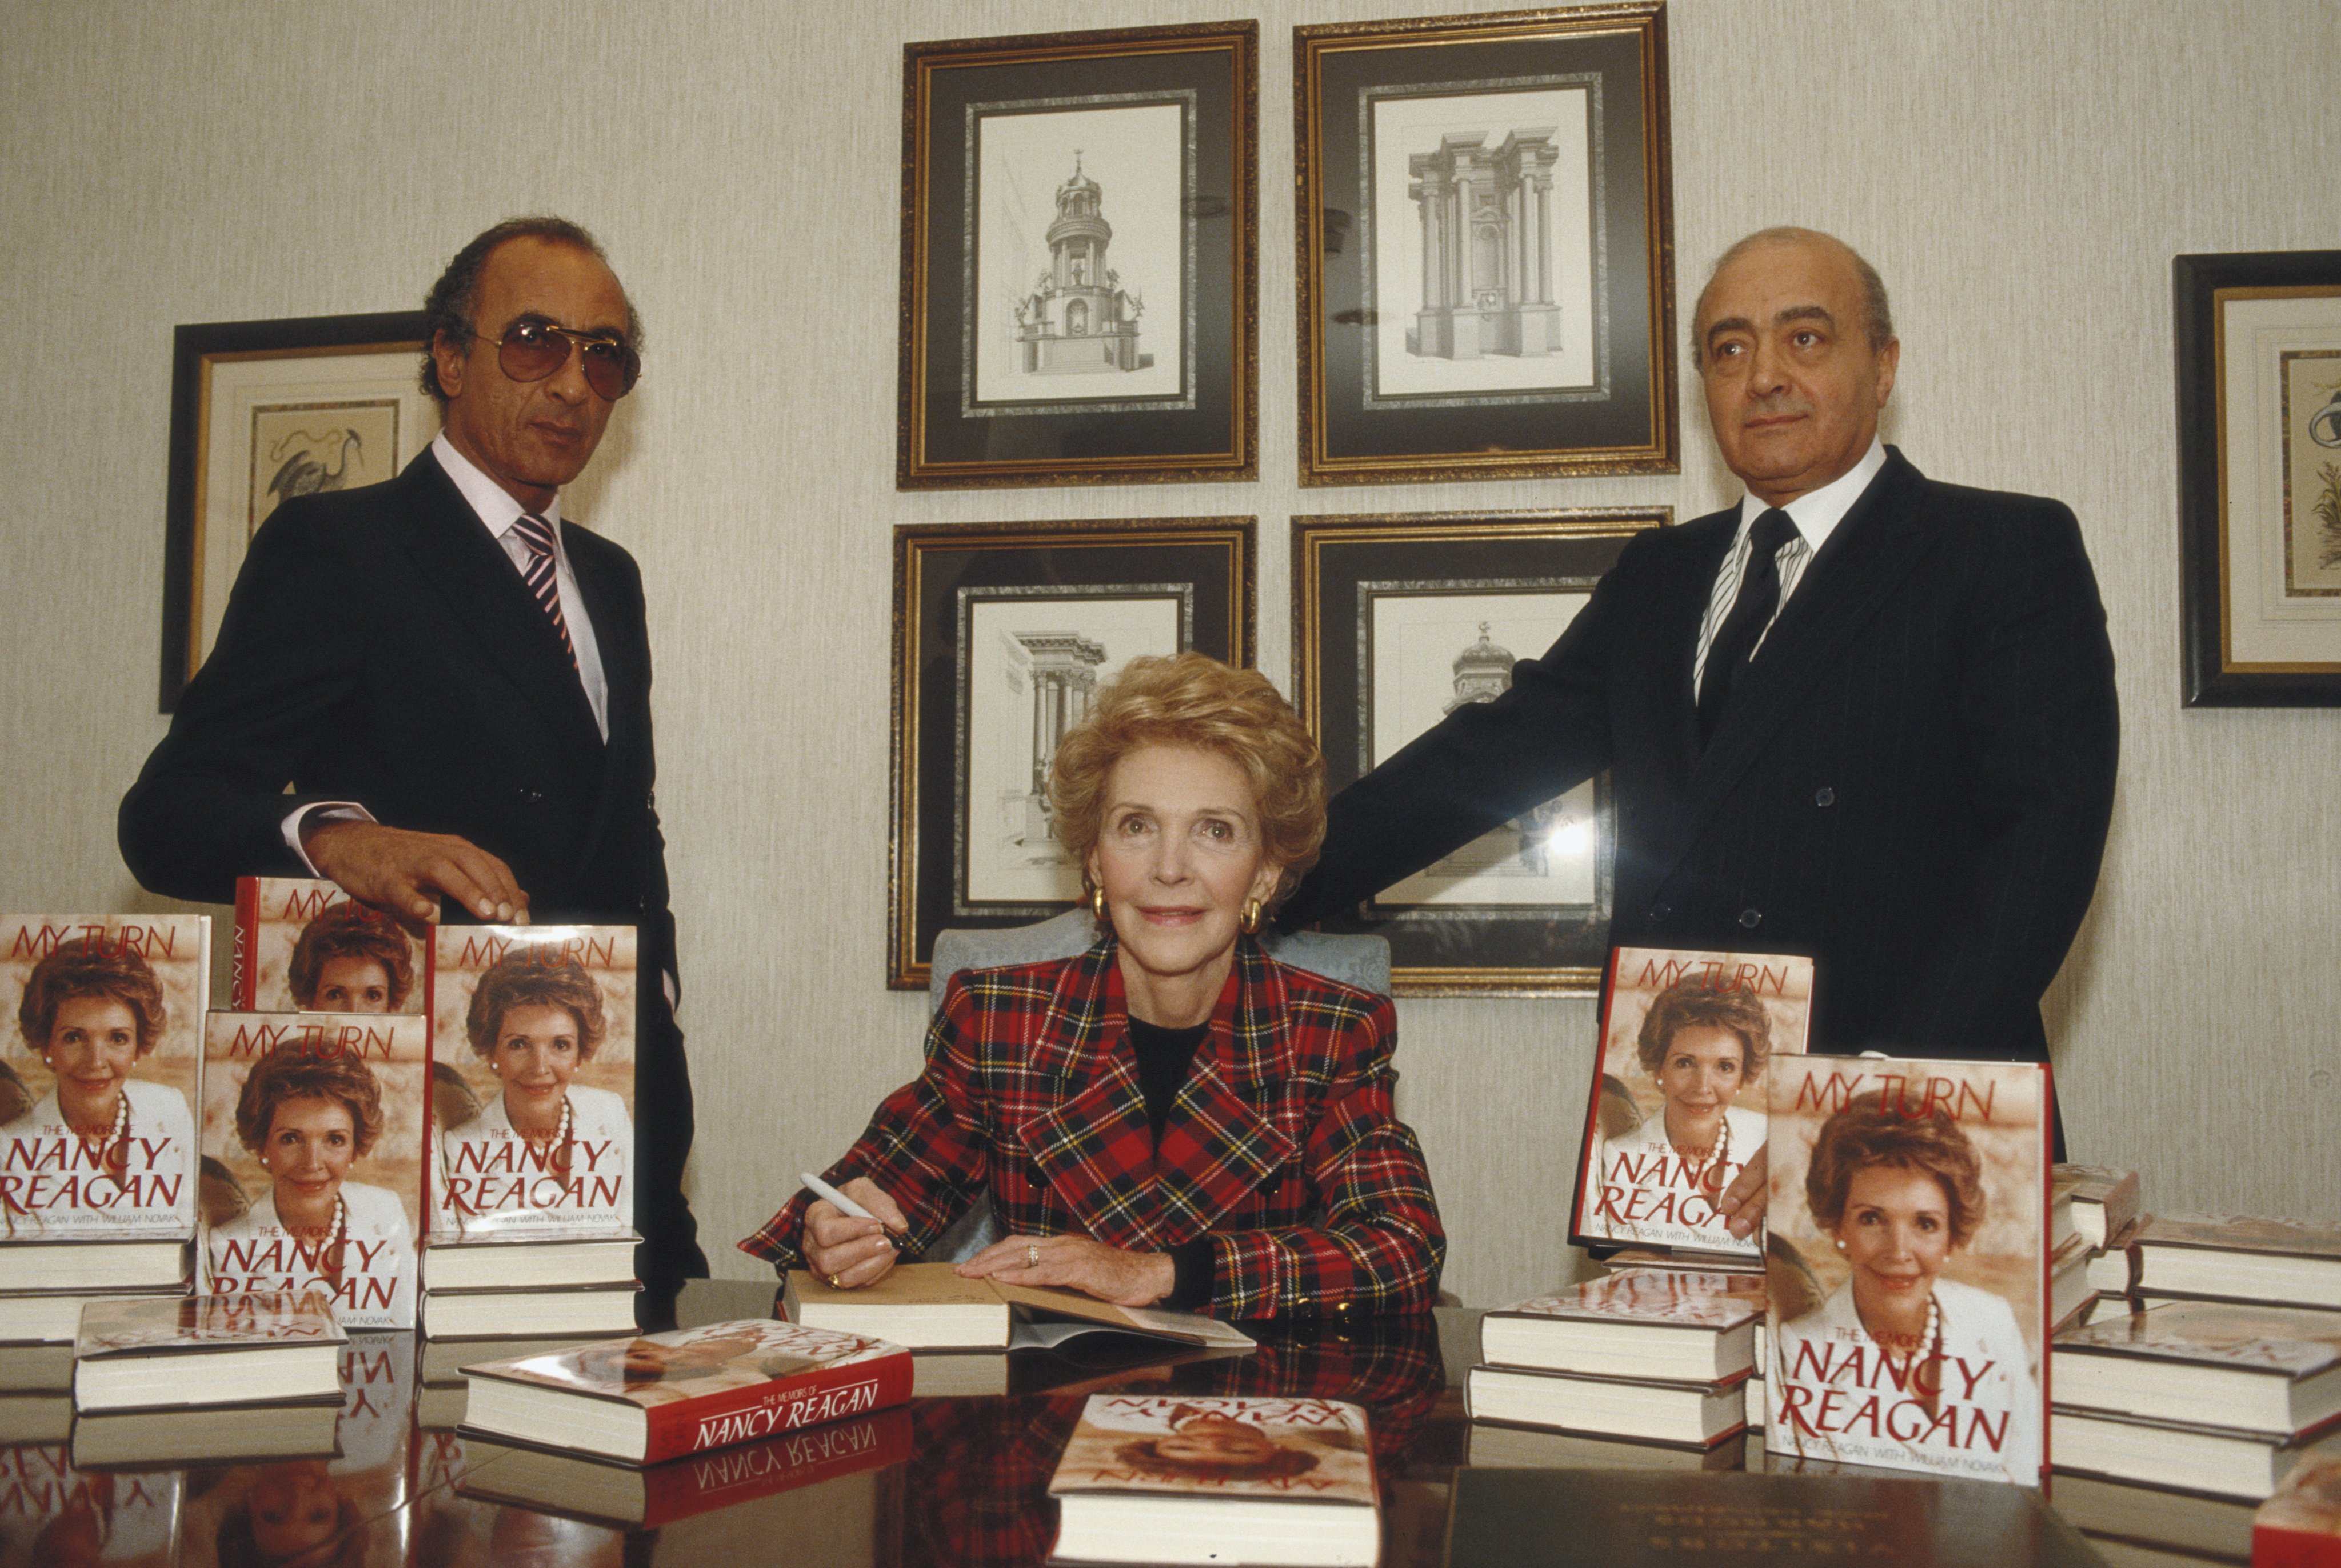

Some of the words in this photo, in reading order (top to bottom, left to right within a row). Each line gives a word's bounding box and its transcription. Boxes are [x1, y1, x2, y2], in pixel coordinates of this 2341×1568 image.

[283, 889, 336, 921] MY
[11, 925, 70, 958] MY
[78, 925, 176, 959] TURN
[458, 935, 513, 968] MY
[231, 925, 245, 1010] NANCY
[1637, 958, 1693, 990] MY
[1699, 961, 1788, 995] TURN
[229, 1023, 289, 1058] MY
[297, 1024, 394, 1060] TURN
[1796, 1071, 1865, 1114] MY
[1873, 1074, 1996, 1121] TURN
[43, 1124, 63, 1135] THE
[489, 1129, 510, 1139] THE
[5, 1137, 172, 1171] NANCY
[454, 1140, 612, 1173] NANCY
[1648, 1142, 1667, 1154] THE
[0, 1174, 183, 1215] REAGAN
[442, 1175, 622, 1216] REAGAN
[1593, 1186, 1733, 1229] REAGA
[73, 1214, 98, 1223] WITH
[102, 1213, 141, 1223] WILLIAM
[145, 1213, 175, 1223] NOVAK
[258, 1226, 279, 1237] THE
[519, 1215, 544, 1224] WITH
[547, 1214, 584, 1223] WILLIAM
[586, 1213, 616, 1222] NOVAK
[1629, 1226, 1663, 1238] REAGAN
[1666, 1230, 1689, 1241] WITH
[1693, 1234, 1729, 1245] WILLIAM
[1732, 1238, 1760, 1249] NOVA
[220, 1239, 387, 1273] NANCY
[359, 1316, 390, 1325] NOVAK
[1835, 1326, 1861, 1343] THE
[1792, 1339, 1996, 1401] NANCY
[763, 1394, 777, 1407] THE
[777, 1387, 808, 1403] MEMOIRS
[808, 1385, 818, 1397] OF
[693, 1405, 782, 1451] NANCY
[786, 1383, 878, 1427] REAGAN
[1122, 1407, 1331, 1425] NANY
[1777, 1384, 2011, 1453] REAGAN
[1873, 1445, 1908, 1461] WITH
[1910, 1450, 1958, 1469] WILLIAM
[1960, 1458, 2000, 1474] NOVAK
